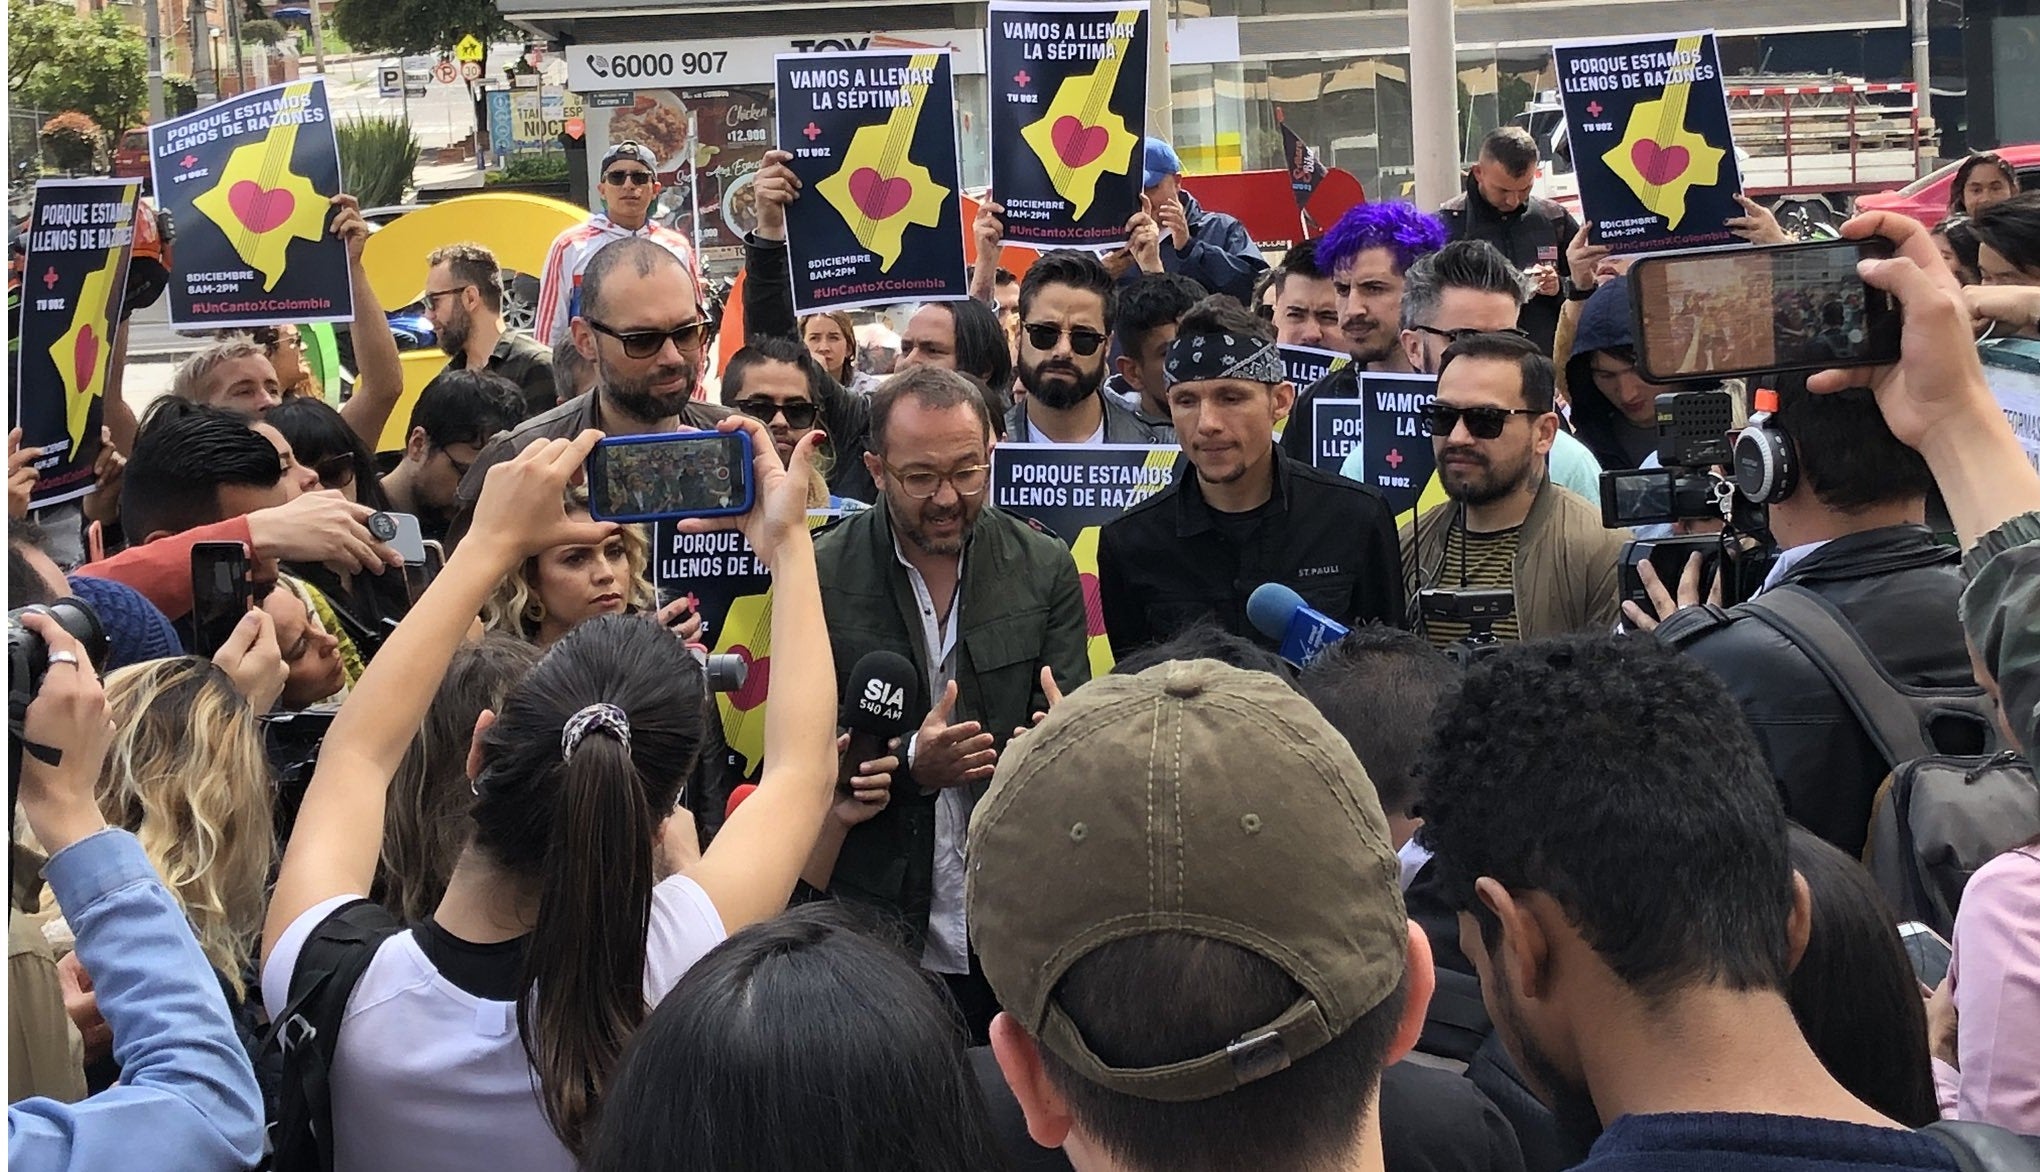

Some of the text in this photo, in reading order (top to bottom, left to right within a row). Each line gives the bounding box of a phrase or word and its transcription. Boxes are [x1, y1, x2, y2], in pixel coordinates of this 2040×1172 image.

[1003, 22, 1134, 40] VAMOS A LLENAR
[1023, 40, 1117, 60] LA SÉPTIMA
[611, 51, 728, 79] 6000 907
[1570, 50, 1702, 75] PORQUE ESTAMOS
[384, 71, 398, 87] P
[790, 67, 934, 89] VAMOS A LLENAR
[1564, 64, 1715, 93] LLENOS DE RAZONES
[812, 87, 914, 110] LA SÉPTIMA
[1007, 93, 1019, 103] TU
[167, 95, 311, 142] PORQUE ESTAMOS
[726, 103, 768, 127] Chicken
[159, 108, 325, 157] LLENOS DE RAZONES
[796, 148, 809, 158] TU
[1006, 199, 1065, 210] 8DICIEMBRE
[41, 203, 89, 228] PORQUE
[1006, 210, 1050, 220] 8AM-2PM
[1600, 216, 1658, 229] 8DICIEMBRE
[32, 229, 77, 252] LLENOS
[80, 229, 96, 250] DE
[1601, 227, 1646, 239] 8AM-2PM
[808, 254, 871, 269] 8DICIEMBRE
[186, 270, 254, 283] 8DICIEMBRE
[809, 267, 856, 281] 8AM-2PM
[187, 283, 239, 295] 8AM-2PM
[813, 278, 946, 299] #UnCantoXColombia
[192, 298, 331, 314] #UnCantoXColombia
[1396, 417, 1417, 437] LA
[1012, 464, 1172, 486] PORQUE ESTAMOS
[1378, 475, 1390, 487] TU
[1000, 487, 1153, 508] LLENOS DE RAZO
[672, 533, 739, 556] PORQUE
[662, 556, 722, 579] LLENOS
[727, 556, 749, 576] DE
[1312, 565, 1339, 575] PAULI
[864, 678, 904, 710] SIA
[859, 698, 903, 721] 540 AM
